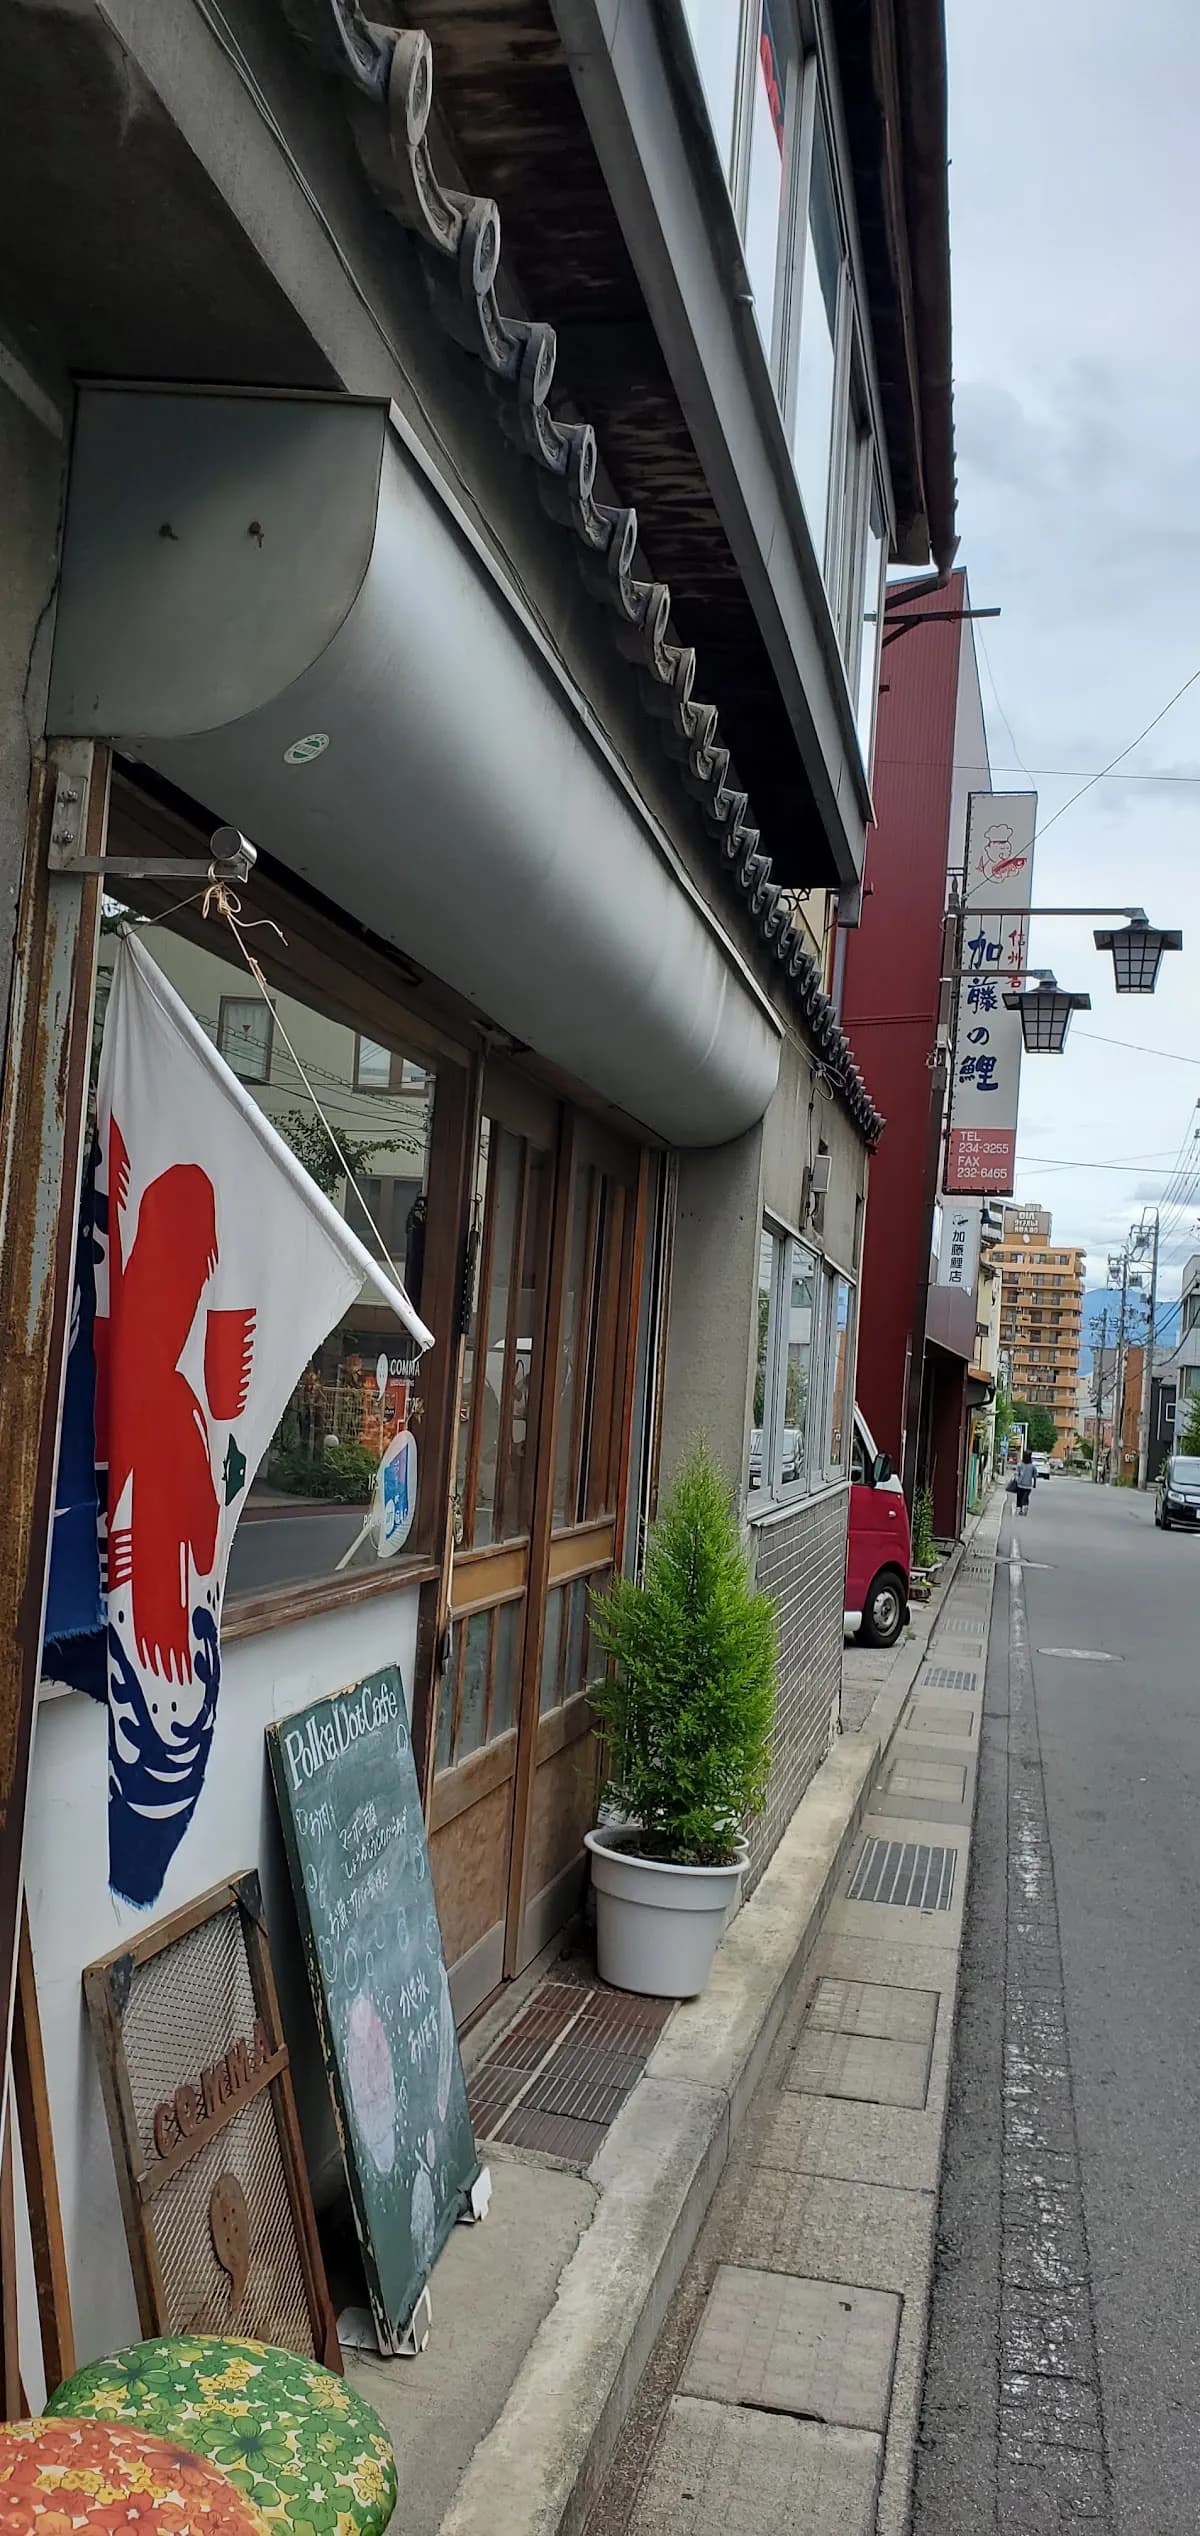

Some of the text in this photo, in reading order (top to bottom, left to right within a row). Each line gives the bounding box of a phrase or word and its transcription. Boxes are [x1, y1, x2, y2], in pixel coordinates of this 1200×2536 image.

[959, 930, 1004, 1091] 加藤の鯉
[960, 1131, 982, 1142] TEL
[959, 1142, 1009, 1154] 234-3255
[957, 1156, 980, 1167] FAX
[957, 1168, 1008, 1179] 232-6465
[949, 1230, 966, 1283] 加藤鯉店
[390, 1359, 421, 1376] COMMA
[284, 1683, 398, 1791] Polka Dot Cafe
[399, 1967, 430, 2018] かき氷
